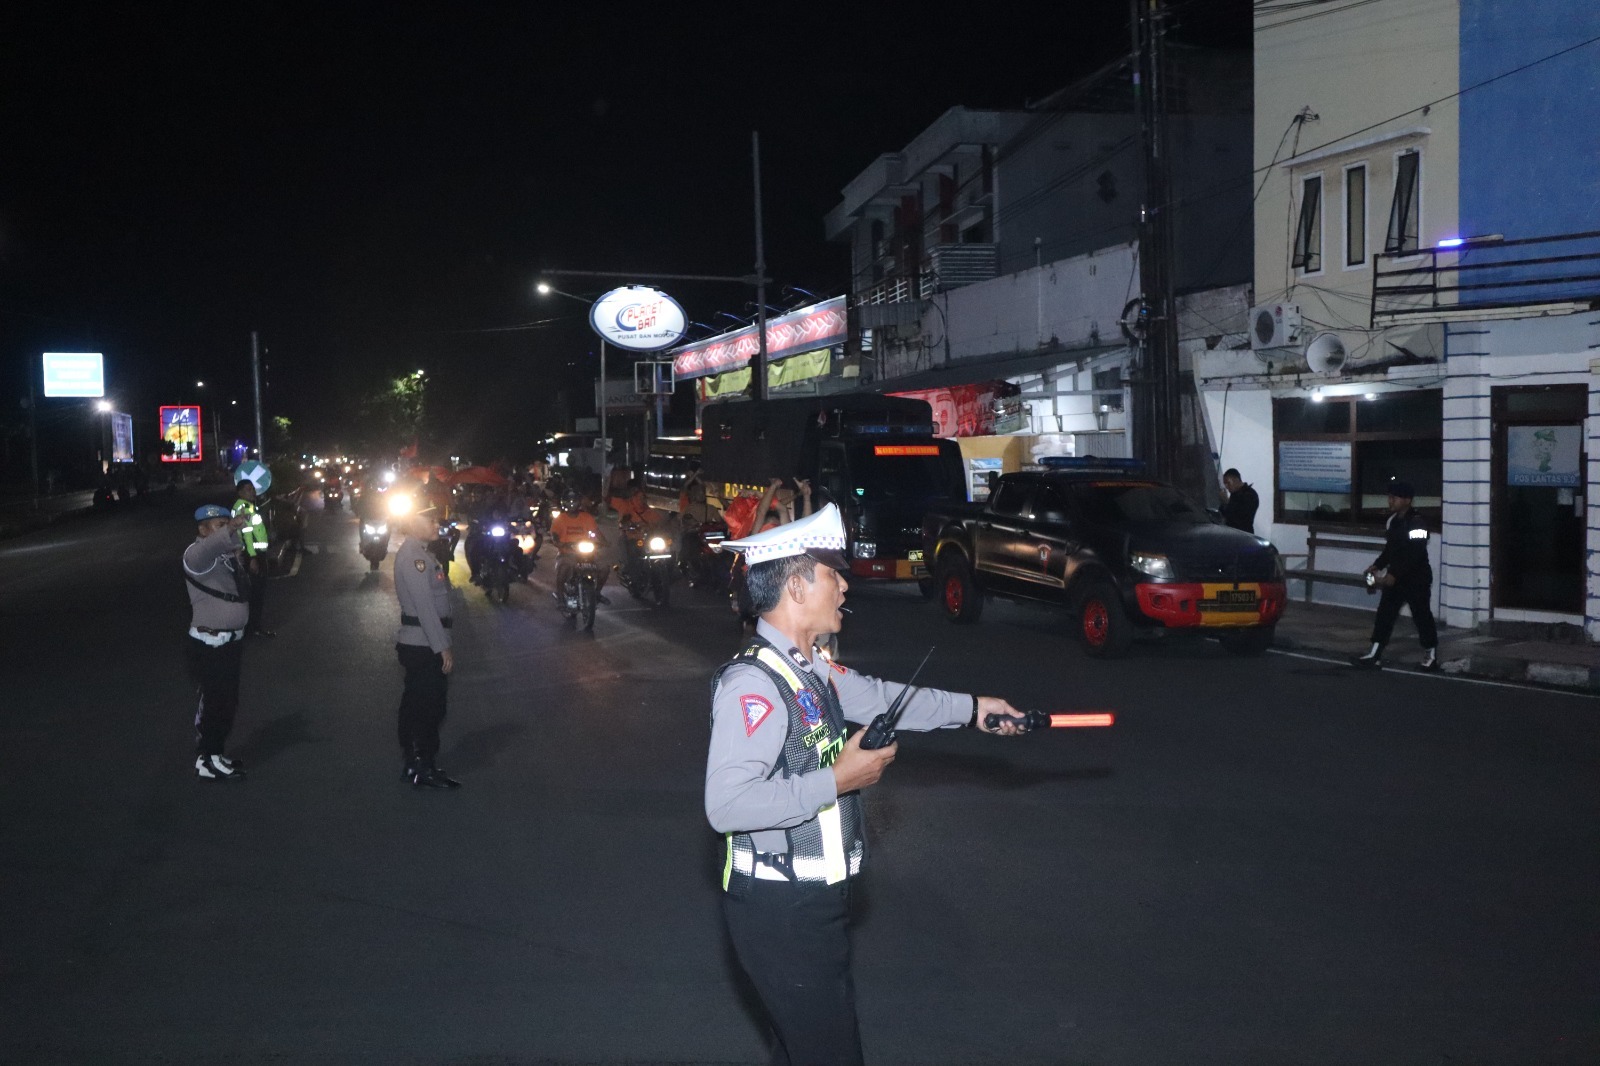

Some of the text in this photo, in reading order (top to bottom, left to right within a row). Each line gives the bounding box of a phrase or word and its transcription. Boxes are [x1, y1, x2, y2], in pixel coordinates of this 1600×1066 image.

[627, 301, 663, 321] PLANET
[637, 316, 656, 330] BAN
[1514, 474, 1529, 483] POS
[1532, 474, 1561, 483] LANTAS
